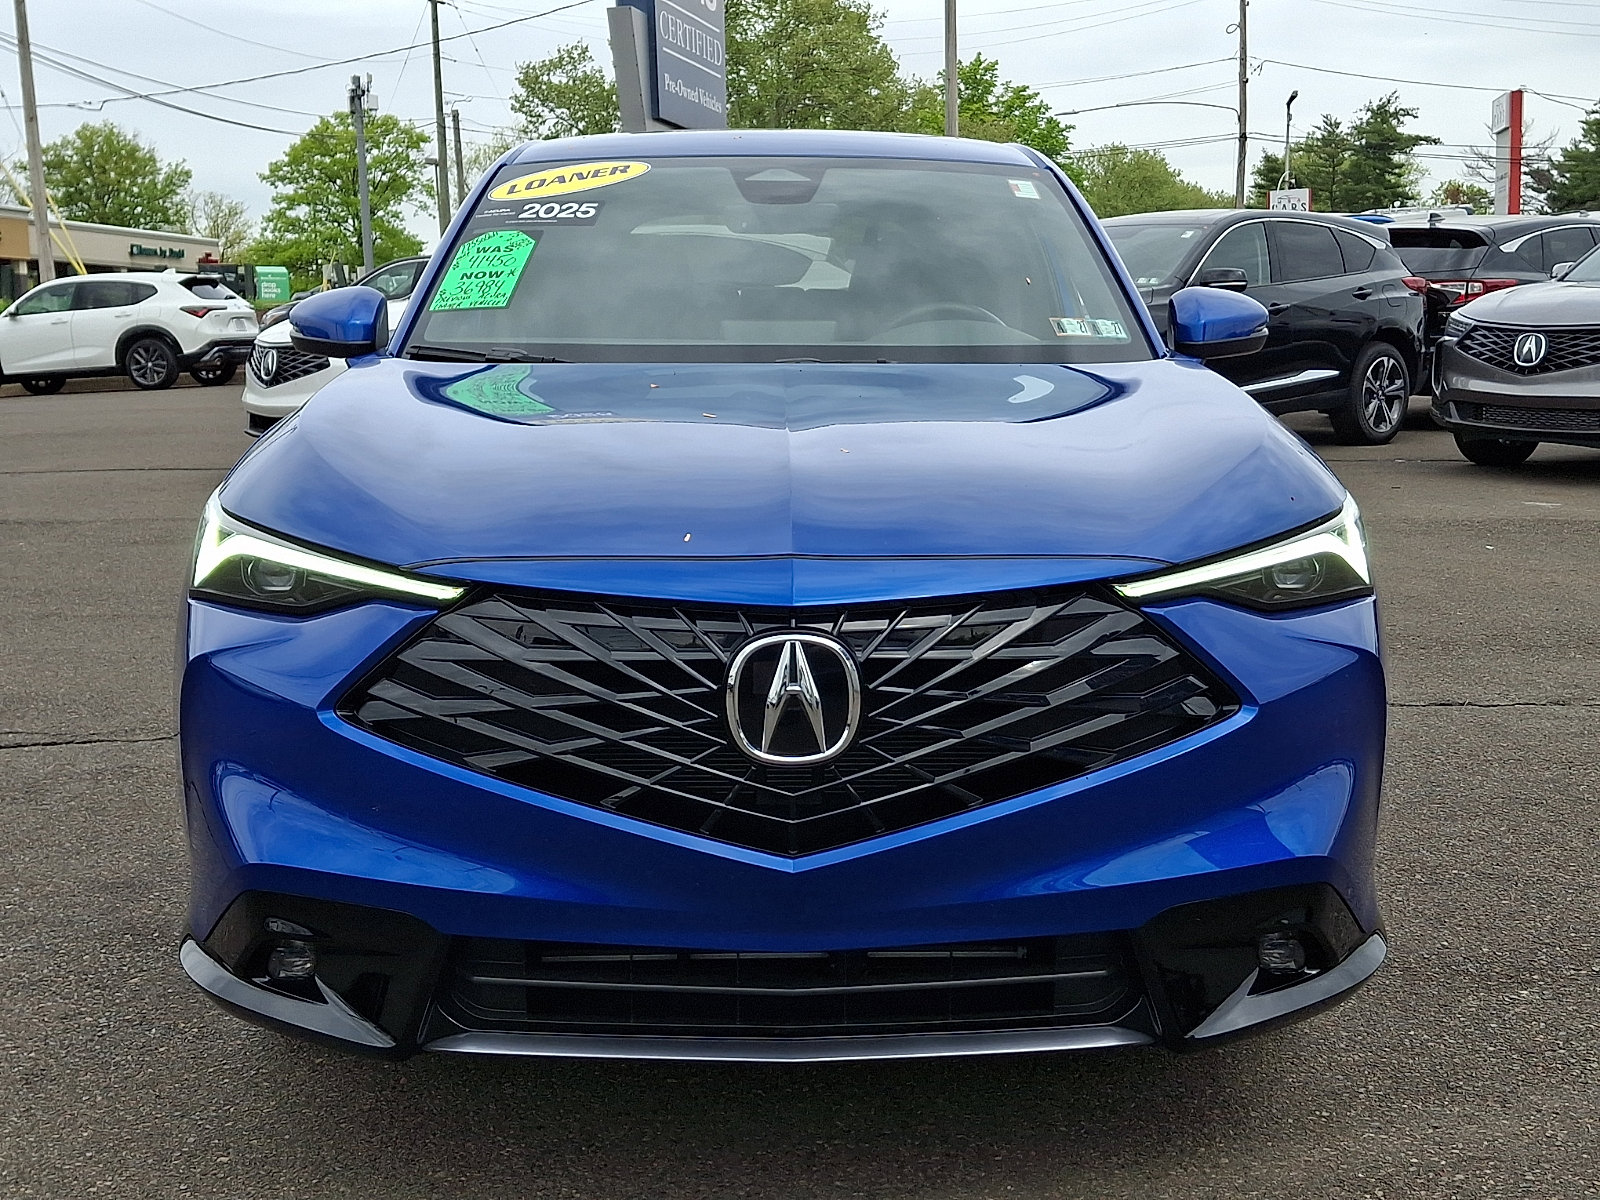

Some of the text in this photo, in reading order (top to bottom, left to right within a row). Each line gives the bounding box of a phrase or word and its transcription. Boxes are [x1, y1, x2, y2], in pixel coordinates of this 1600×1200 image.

[660, 11, 722, 66] CERTIFIED
[664, 73, 722, 113] Pre-Owned Vehicles
[506, 165, 631, 195] LOANER
[518, 202, 599, 219] 2025
[476, 245, 514, 254] WAS
[460, 270, 505, 281] NOW
